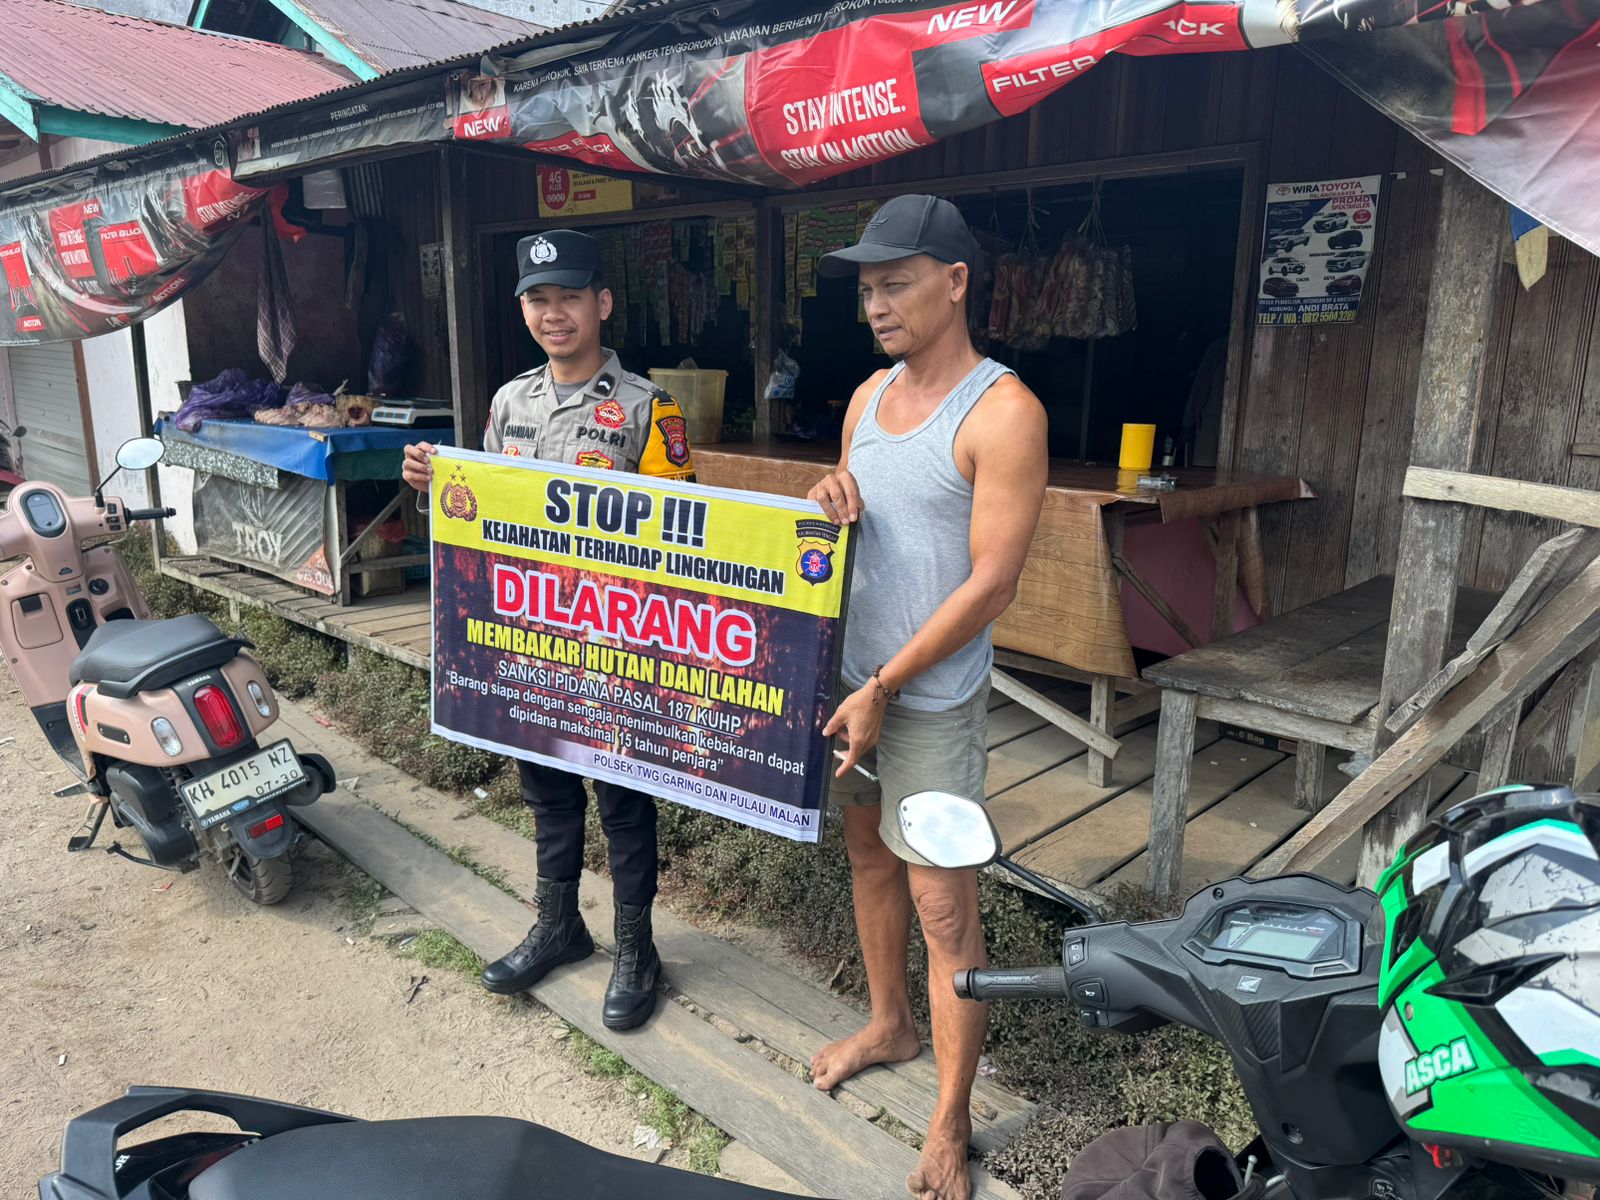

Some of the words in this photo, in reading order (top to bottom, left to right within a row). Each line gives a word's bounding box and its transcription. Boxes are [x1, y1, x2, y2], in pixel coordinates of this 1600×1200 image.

[927, 0, 1014, 35] NEW
[513, 76, 539, 92] KARENA
[573, 63, 589, 76] SAYA
[589, 54, 625, 73] TERKENA
[625, 46, 659, 65] KANKER
[724, 24, 771, 44] LAYANAN
[771, 13, 823, 34] BERHENTI
[991, 55, 1099, 93] FILTER
[782, 97, 827, 136] STAY
[825, 78, 907, 127] INTENSE.
[463, 115, 501, 138] NEW
[780, 147, 817, 170] STAY
[821, 140, 843, 165] IN
[549, 170, 562, 184] 4G
[1292, 183, 1319, 194] WIRA
[1319, 181, 1362, 192] TOYOTA
[83, 203, 100, 215] NEW
[1331, 195, 1370, 204] PROMO
[152, 278, 185, 303] MOTION
[1298, 304, 1319, 313] ANDI
[1321, 302, 1349, 311] BRATA
[1258, 312, 1276, 324] TELP
[576, 425, 627, 448] POLRI
[544, 478, 654, 537] STOP
[661, 496, 708, 549] !!!
[232, 522, 283, 567] TROY
[482, 518, 571, 556] KEJAHATAN
[574, 535, 663, 572] TERHADAP
[665, 552, 785, 596] LINGKUNGAN
[494, 563, 757, 667] DILARANG
[186, 674, 212, 687] YAMAHA
[466, 618, 582, 667] MEMBAKAR
[585, 643, 656, 684] HUTAN
[659, 660, 707, 697] DAN
[709, 672, 785, 717] LAHAN
[498, 660, 551, 687] SANKSI
[555, 672, 611, 702] PIDANA
[613, 686, 662, 714] PASAL
[667, 700, 693, 721] 187
[696, 706, 742, 734] KUHP
[491, 682, 520, 702] siapa
[522, 689, 565, 712] dengan
[567, 702, 613, 724] sengaja
[615, 713, 696, 745] menimbulkan
[699, 732, 764, 765] kebakaran
[767, 752, 805, 776] dapat
[509, 705, 557, 729] dipidana
[560, 718, 616, 744] maksimal
[618, 731, 632, 748] 15
[635, 734, 674, 758] tahun
[188, 781, 215, 804] KH
[221, 760, 260, 790] 4015
[268, 747, 292, 768] NZ
[593, 753, 634, 774] POLSEK
[636, 764, 660, 782] TWG
[662, 772, 702, 794] GARING
[705, 785, 727, 803] DAN
[730, 792, 767, 814] PULAU
[769, 805, 811, 827] MALAN
[207, 810, 231, 824] YAMAHA
[1405, 1036, 1478, 1097] ASCA
